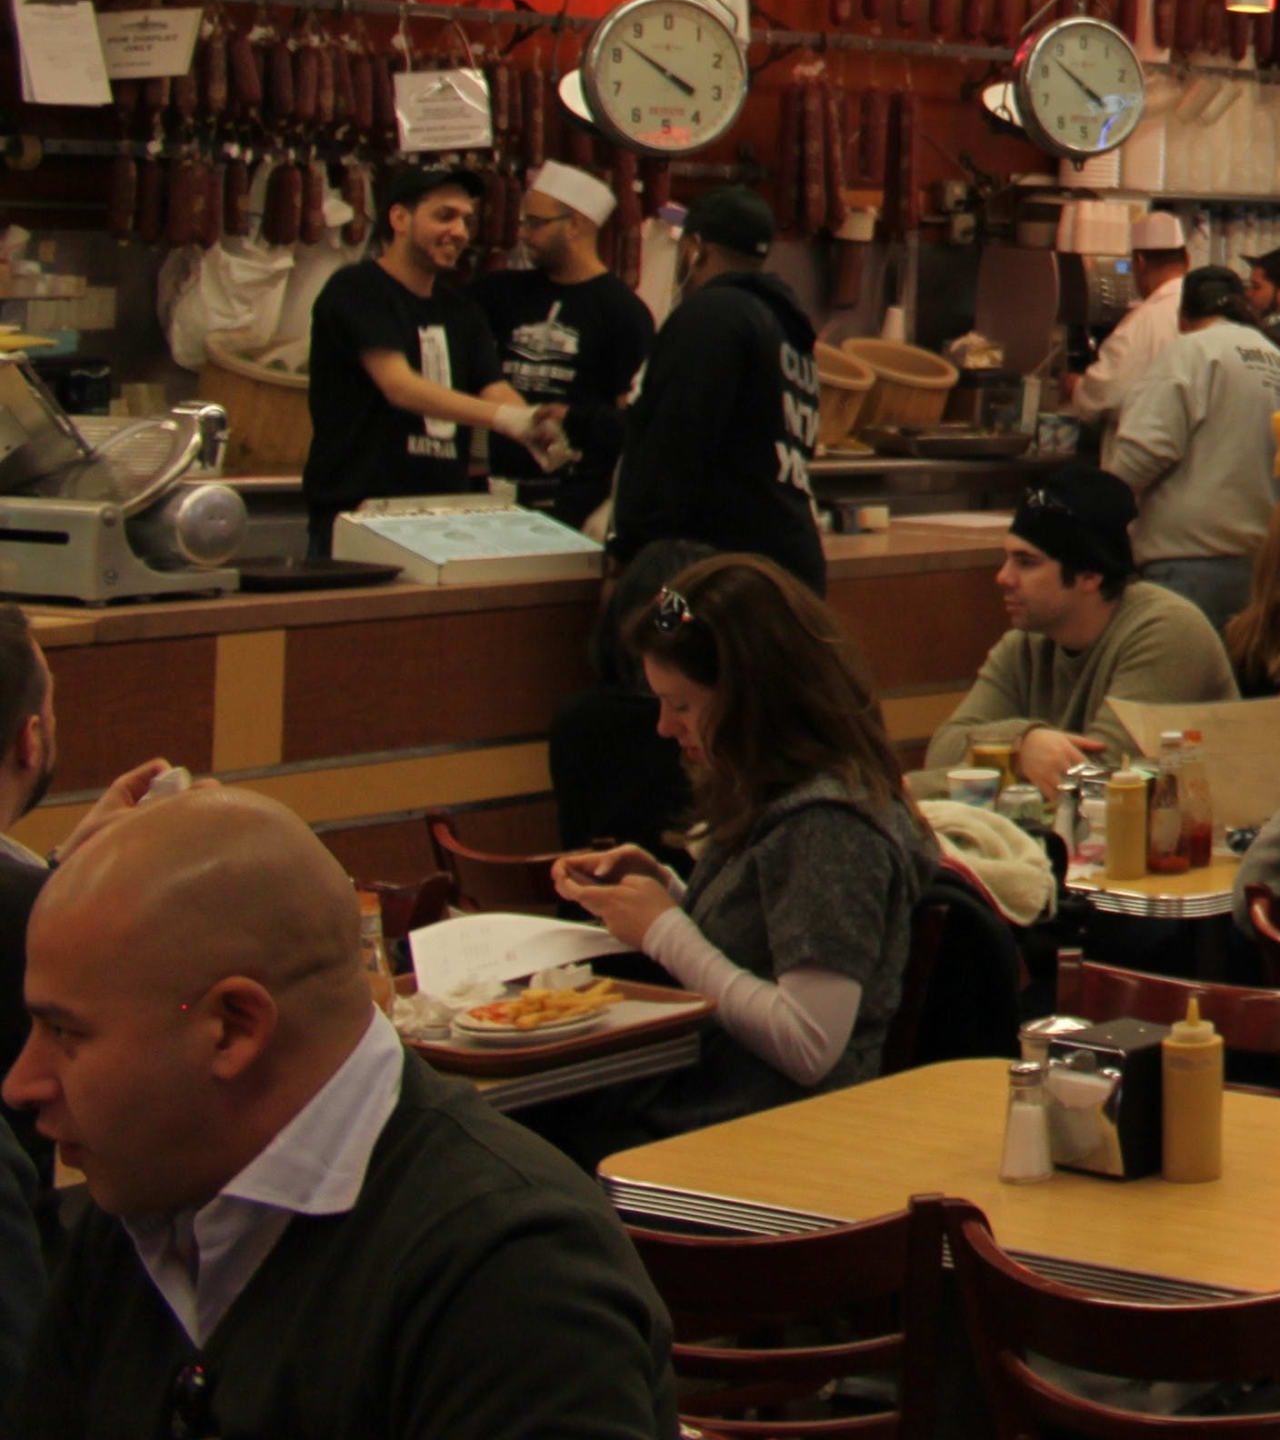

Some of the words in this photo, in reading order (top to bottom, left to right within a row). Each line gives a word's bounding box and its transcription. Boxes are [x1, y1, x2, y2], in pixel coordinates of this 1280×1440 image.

[664, 14, 673, 30] 0
[633, 23, 643, 38] 9
[612, 48, 622, 63] 8
[713, 54, 722, 69] 2
[613, 82, 621, 95] 7
[713, 86, 722, 101] 3
